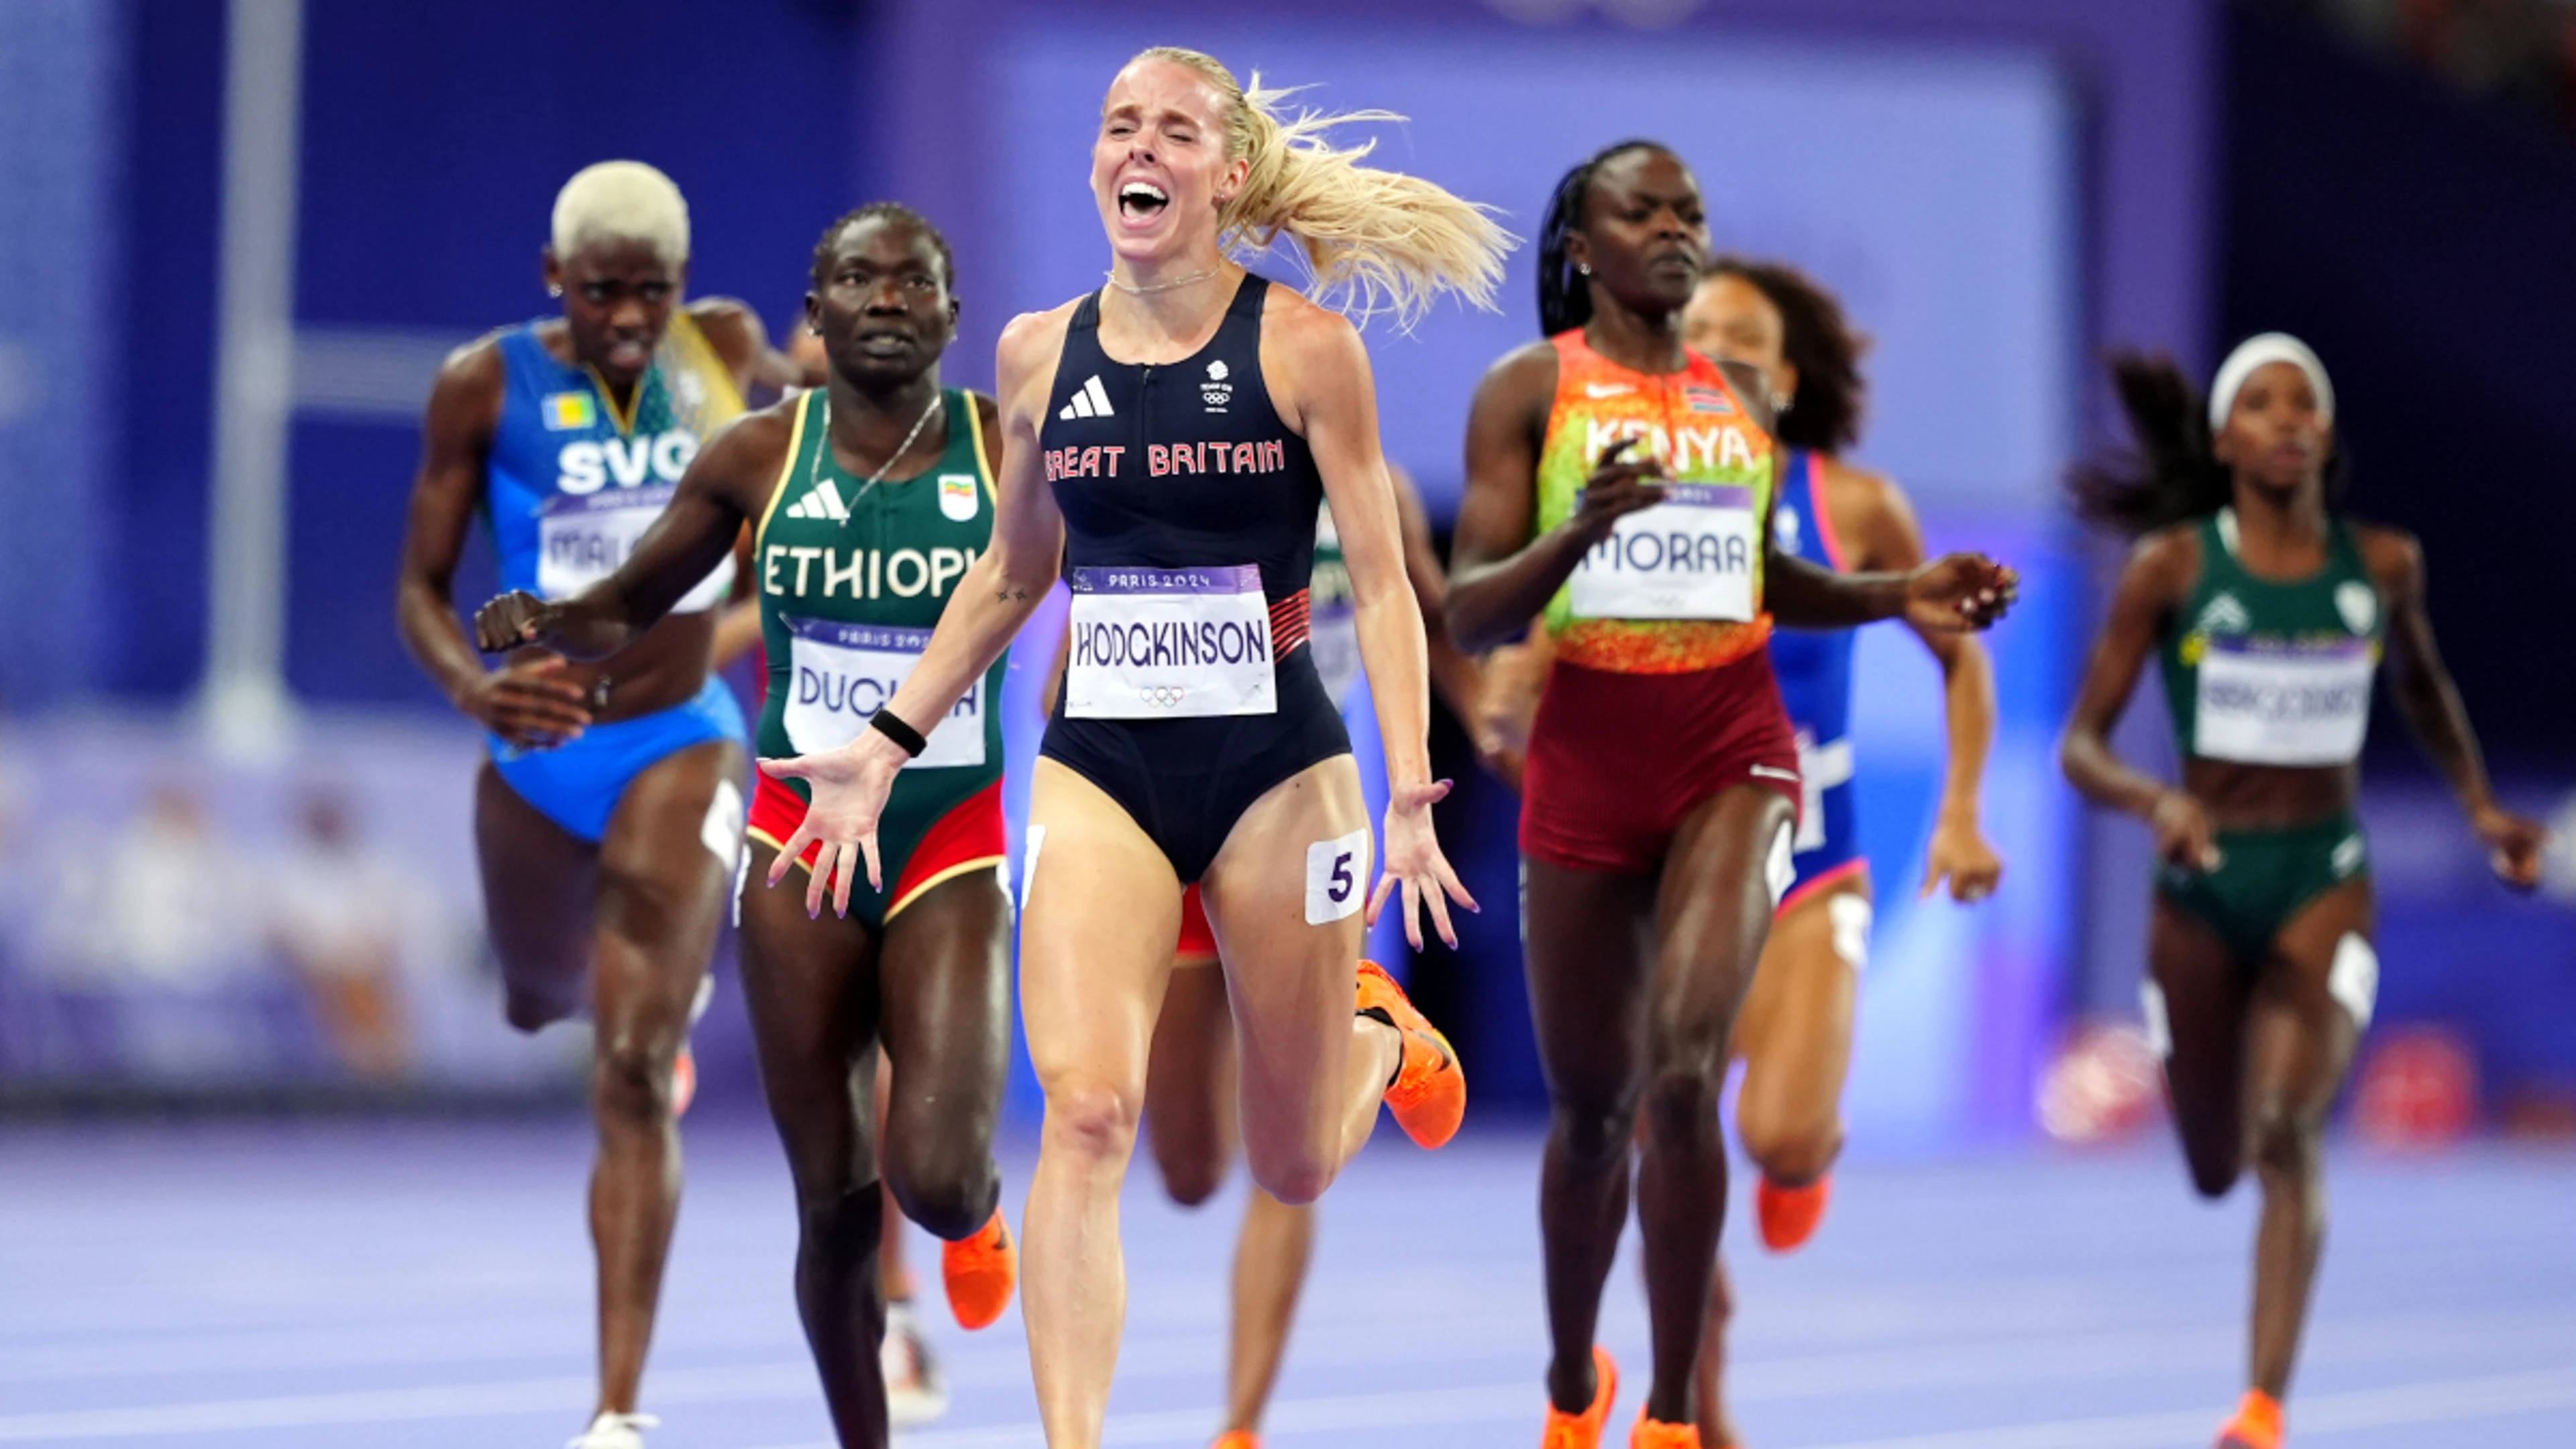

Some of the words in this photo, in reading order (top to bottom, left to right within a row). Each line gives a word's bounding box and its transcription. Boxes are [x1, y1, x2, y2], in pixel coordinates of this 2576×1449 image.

[1148, 439, 1284, 476] BRITAIN
[1109, 574, 1158, 588] PARIS
[1162, 574, 1210, 588] 2024
[1077, 619, 1266, 666] HODGKINSON
[799, 665, 977, 718] DUGA
[1328, 851, 1354, 903] 5
